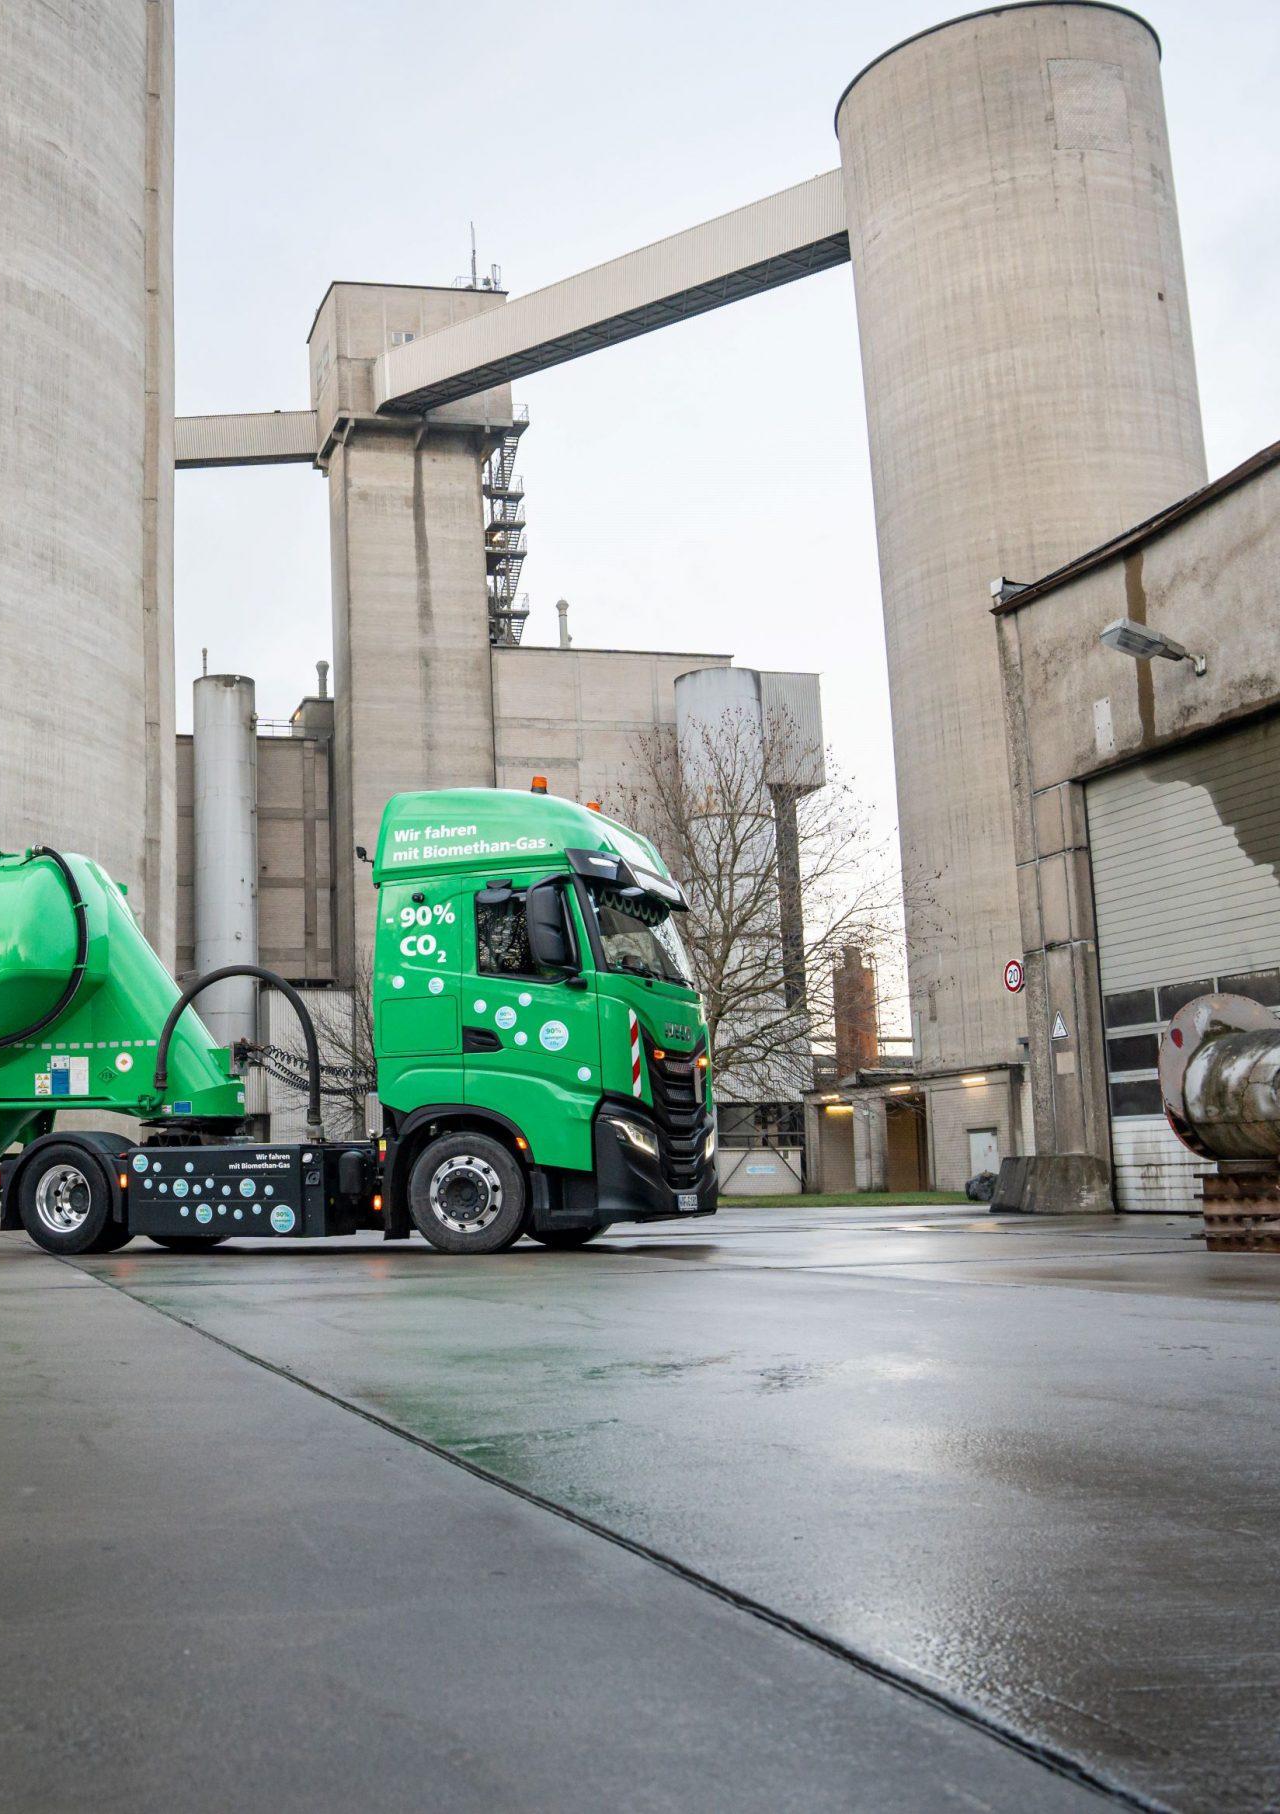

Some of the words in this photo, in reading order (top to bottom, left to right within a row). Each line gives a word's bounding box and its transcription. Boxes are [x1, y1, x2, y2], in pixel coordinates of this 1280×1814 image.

[394, 830, 420, 843] Wir
[425, 825, 477, 839] fahren
[393, 847, 419, 861] mit
[423, 837, 546, 859] Biomethan-Gas
[400, 903, 455, 928] 90%
[1009, 968, 1019, 984] 20
[229, 1161, 240, 1169] mit
[241, 1160, 290, 1169] Biomethan-Gas
[269, 1152, 290, 1160] fahren
